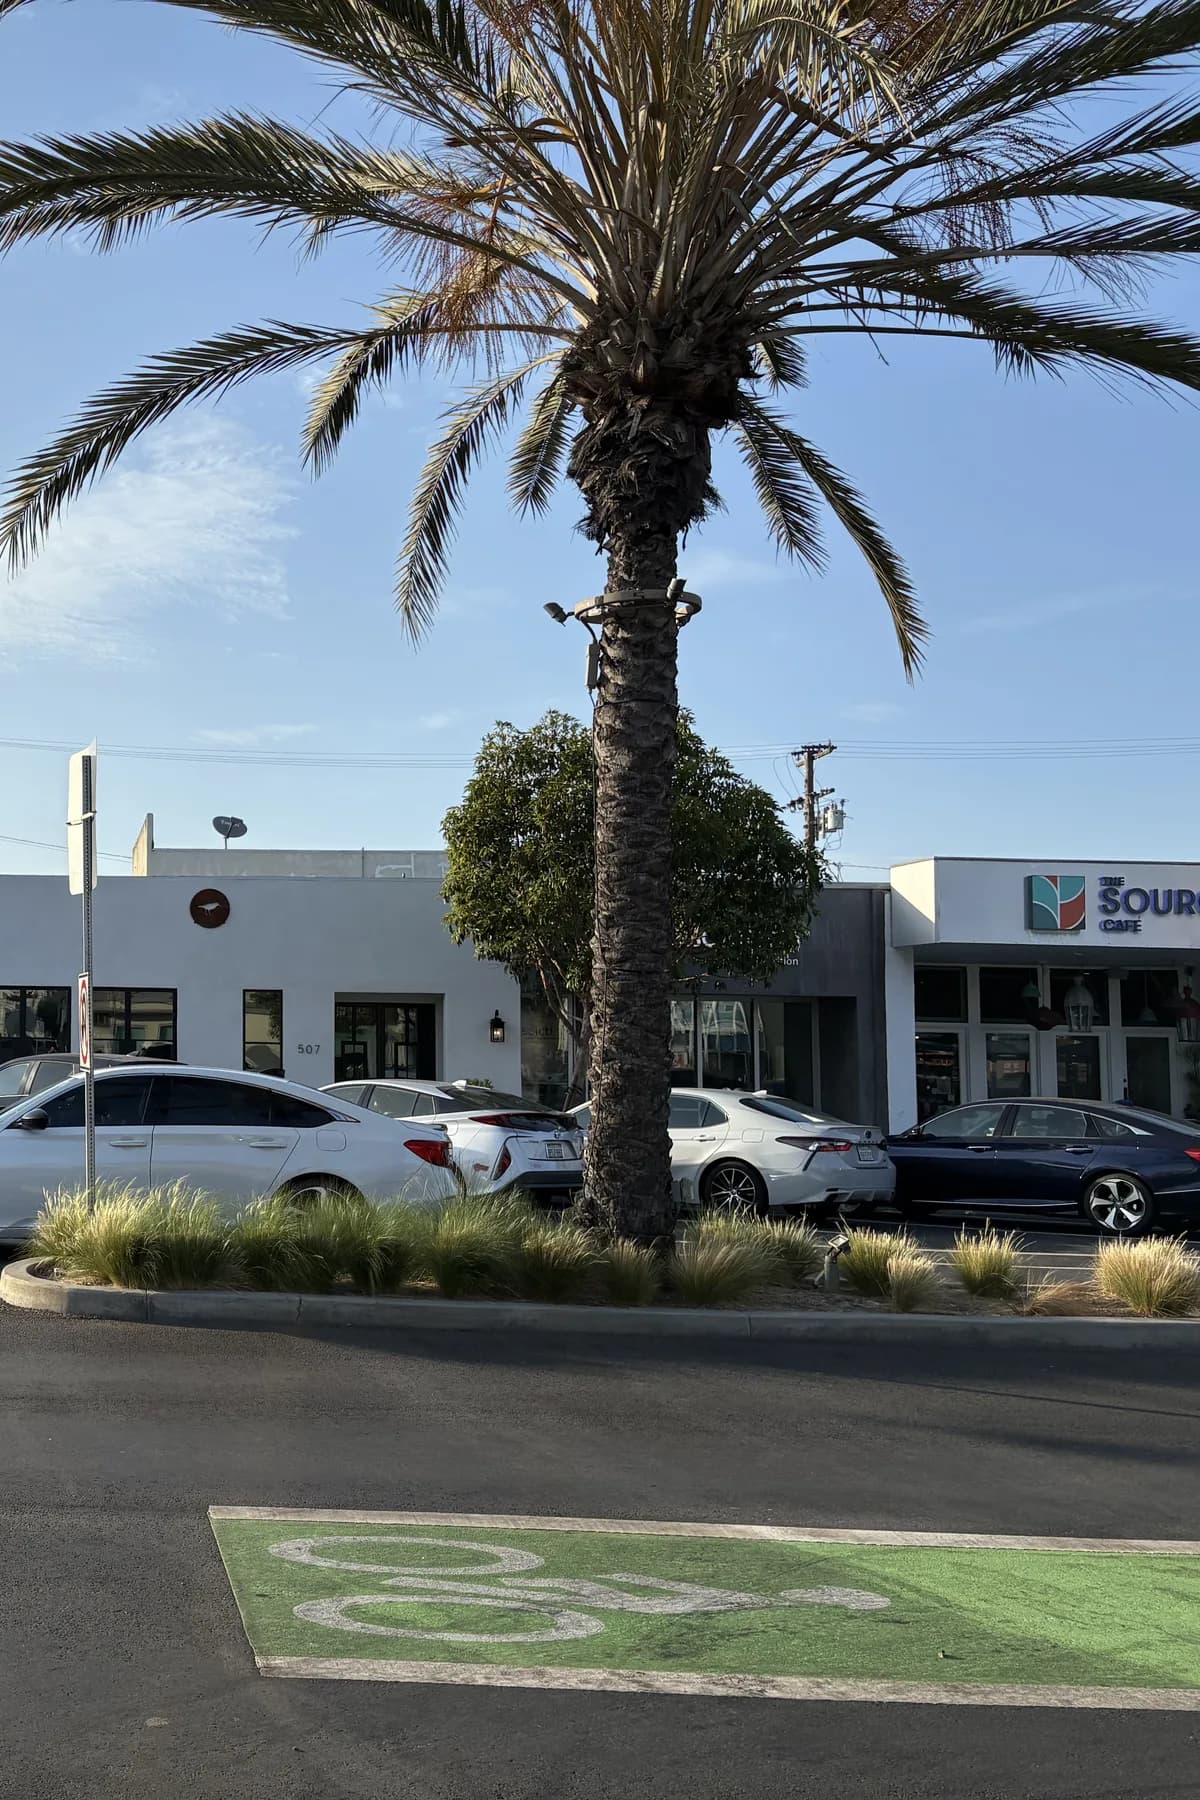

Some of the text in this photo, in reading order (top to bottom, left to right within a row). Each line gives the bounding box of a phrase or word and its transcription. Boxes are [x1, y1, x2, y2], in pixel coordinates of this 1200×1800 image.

[1098, 876, 1125, 887] THE
[1098, 887, 1200, 915] SOUR
[297, 1044, 321, 1055] 507
